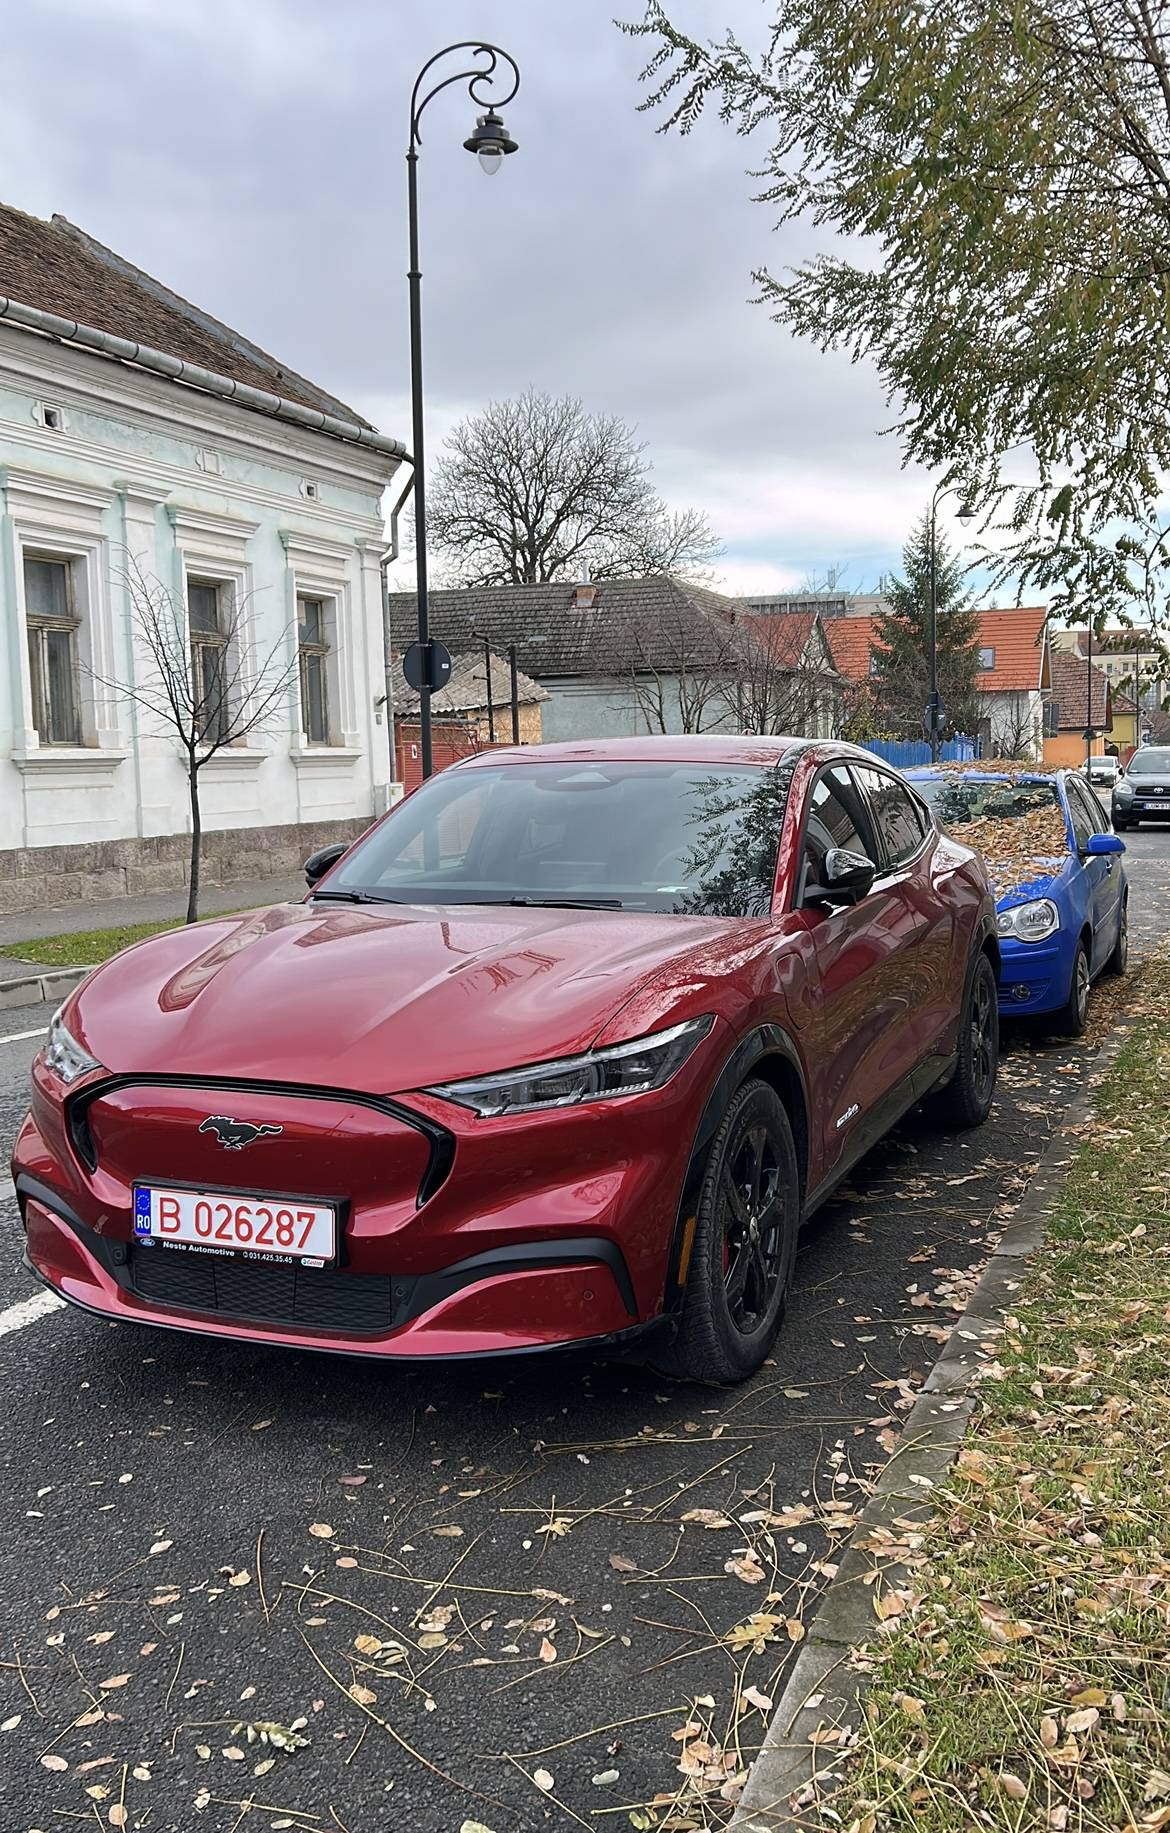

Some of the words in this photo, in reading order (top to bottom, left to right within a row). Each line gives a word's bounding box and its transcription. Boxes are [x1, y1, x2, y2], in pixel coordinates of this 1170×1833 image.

[137, 1214, 151, 1229] RO
[160, 1197, 181, 1233] B
[195, 1201, 316, 1249] 026287
[162, 1241, 187, 1251] Neste
[188, 1244, 235, 1257] Automotive
